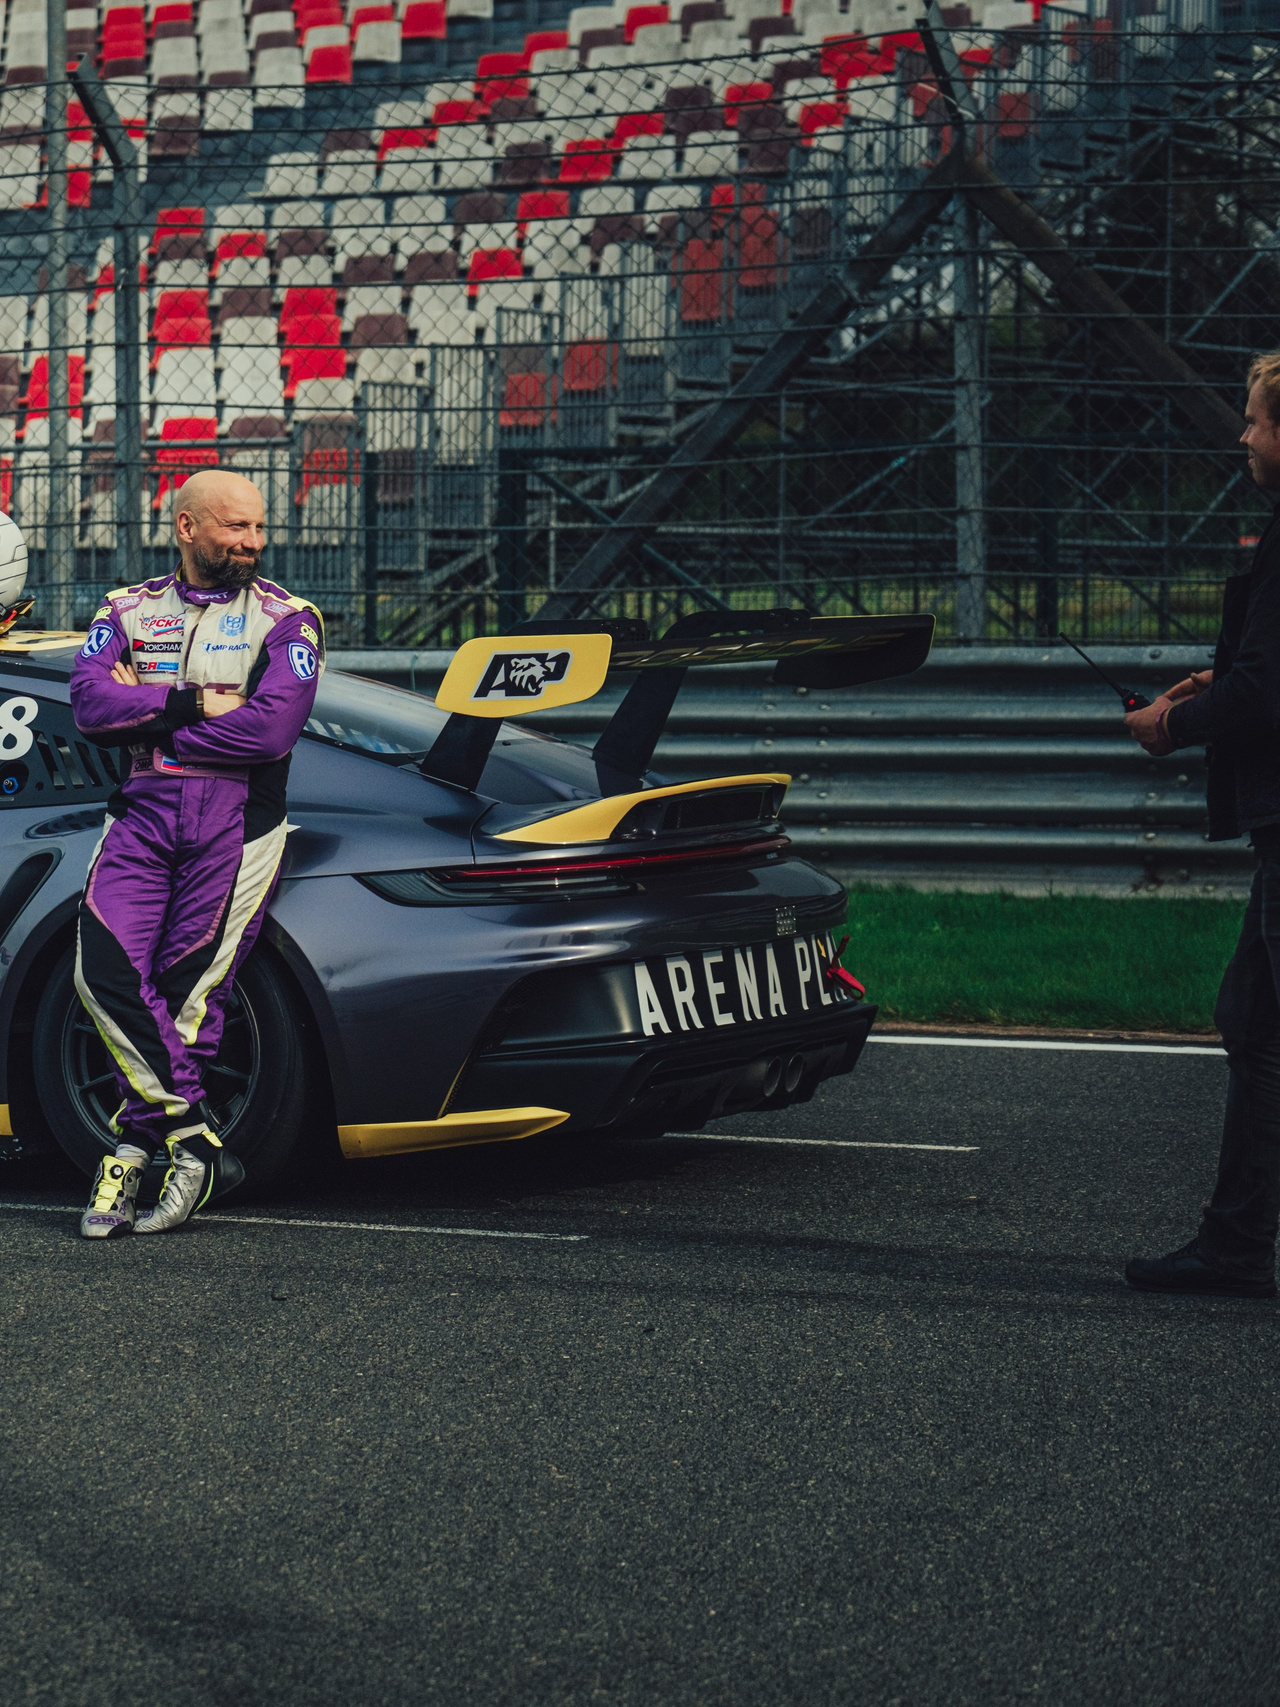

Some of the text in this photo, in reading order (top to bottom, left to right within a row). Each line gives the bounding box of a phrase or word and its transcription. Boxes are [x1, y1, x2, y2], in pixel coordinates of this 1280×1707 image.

[116, 597, 140, 608] OMP
[143, 643, 182, 651] YOKOHAM
[211, 643, 250, 652] SMP RACIN
[136, 661, 158, 670] TCR
[634, 942, 788, 1037] ARENA
